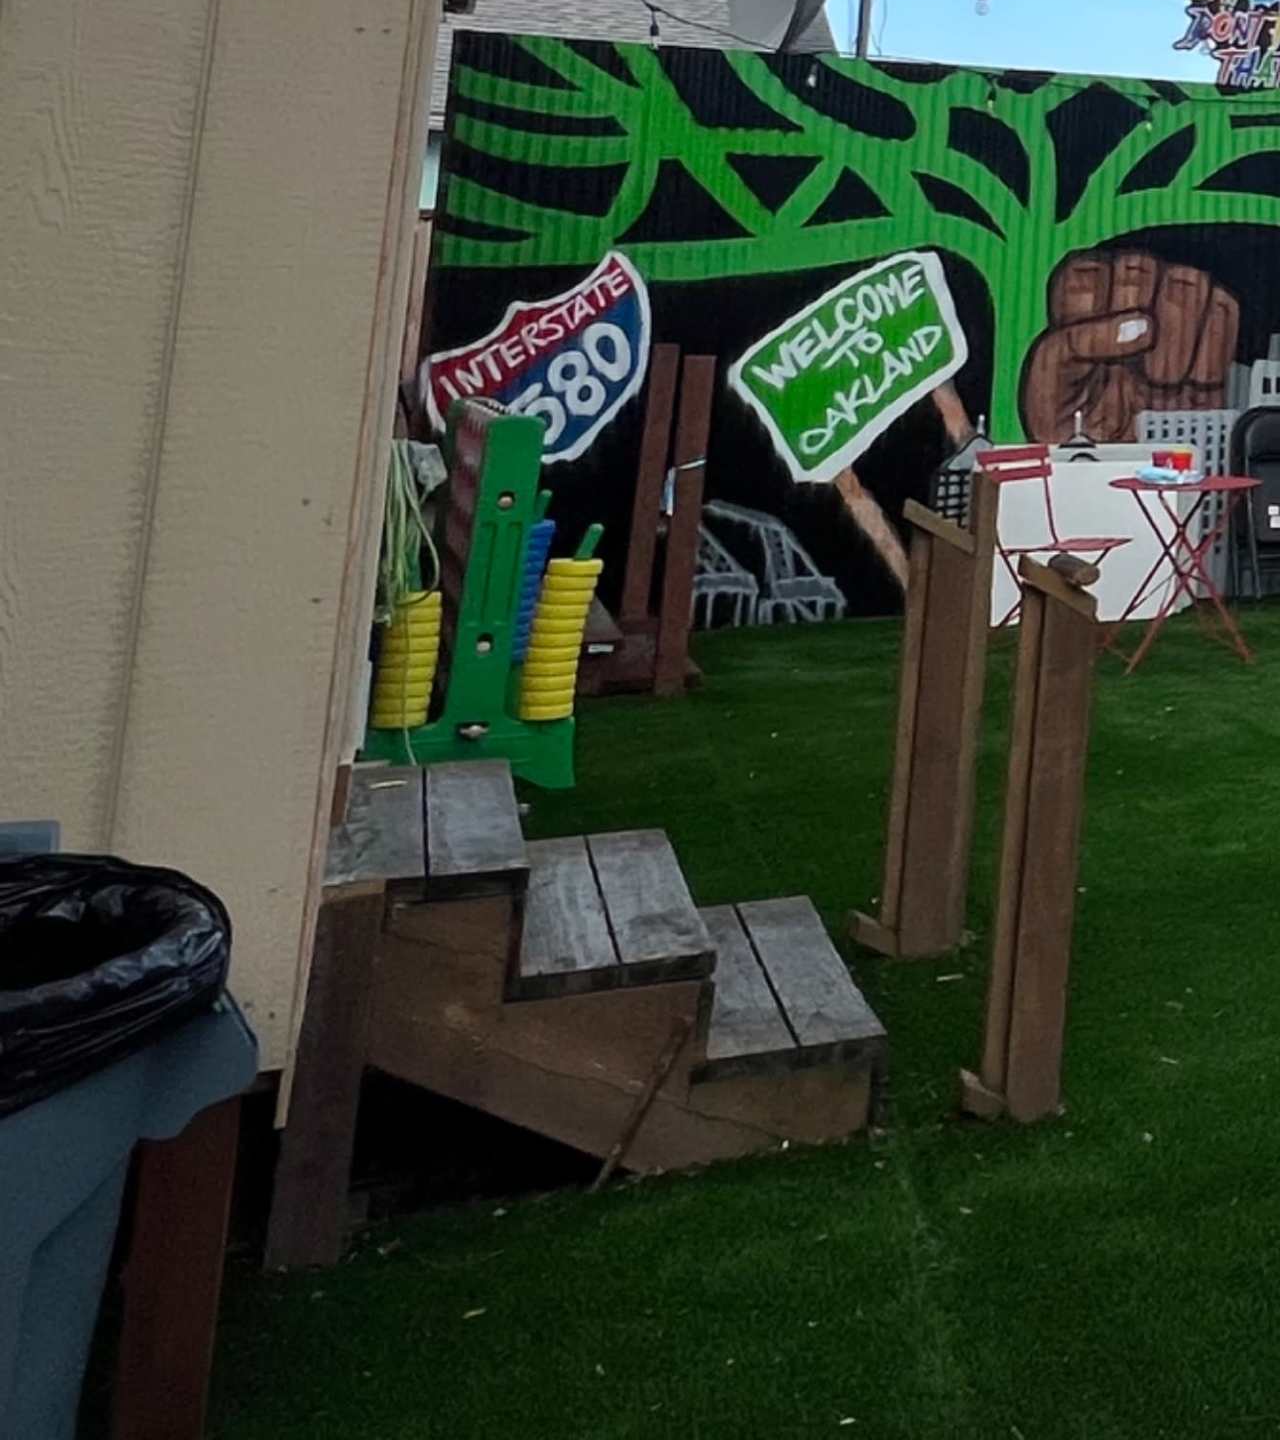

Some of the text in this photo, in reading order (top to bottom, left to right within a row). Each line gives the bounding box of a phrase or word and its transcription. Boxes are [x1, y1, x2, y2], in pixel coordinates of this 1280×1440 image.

[439, 267, 630, 402] INTERSTATE
[507, 322, 632, 446] 580
[751, 263, 925, 390] WELCOME
[800, 324, 943, 455] OAKLAND
[820, 326, 884, 369] TO
